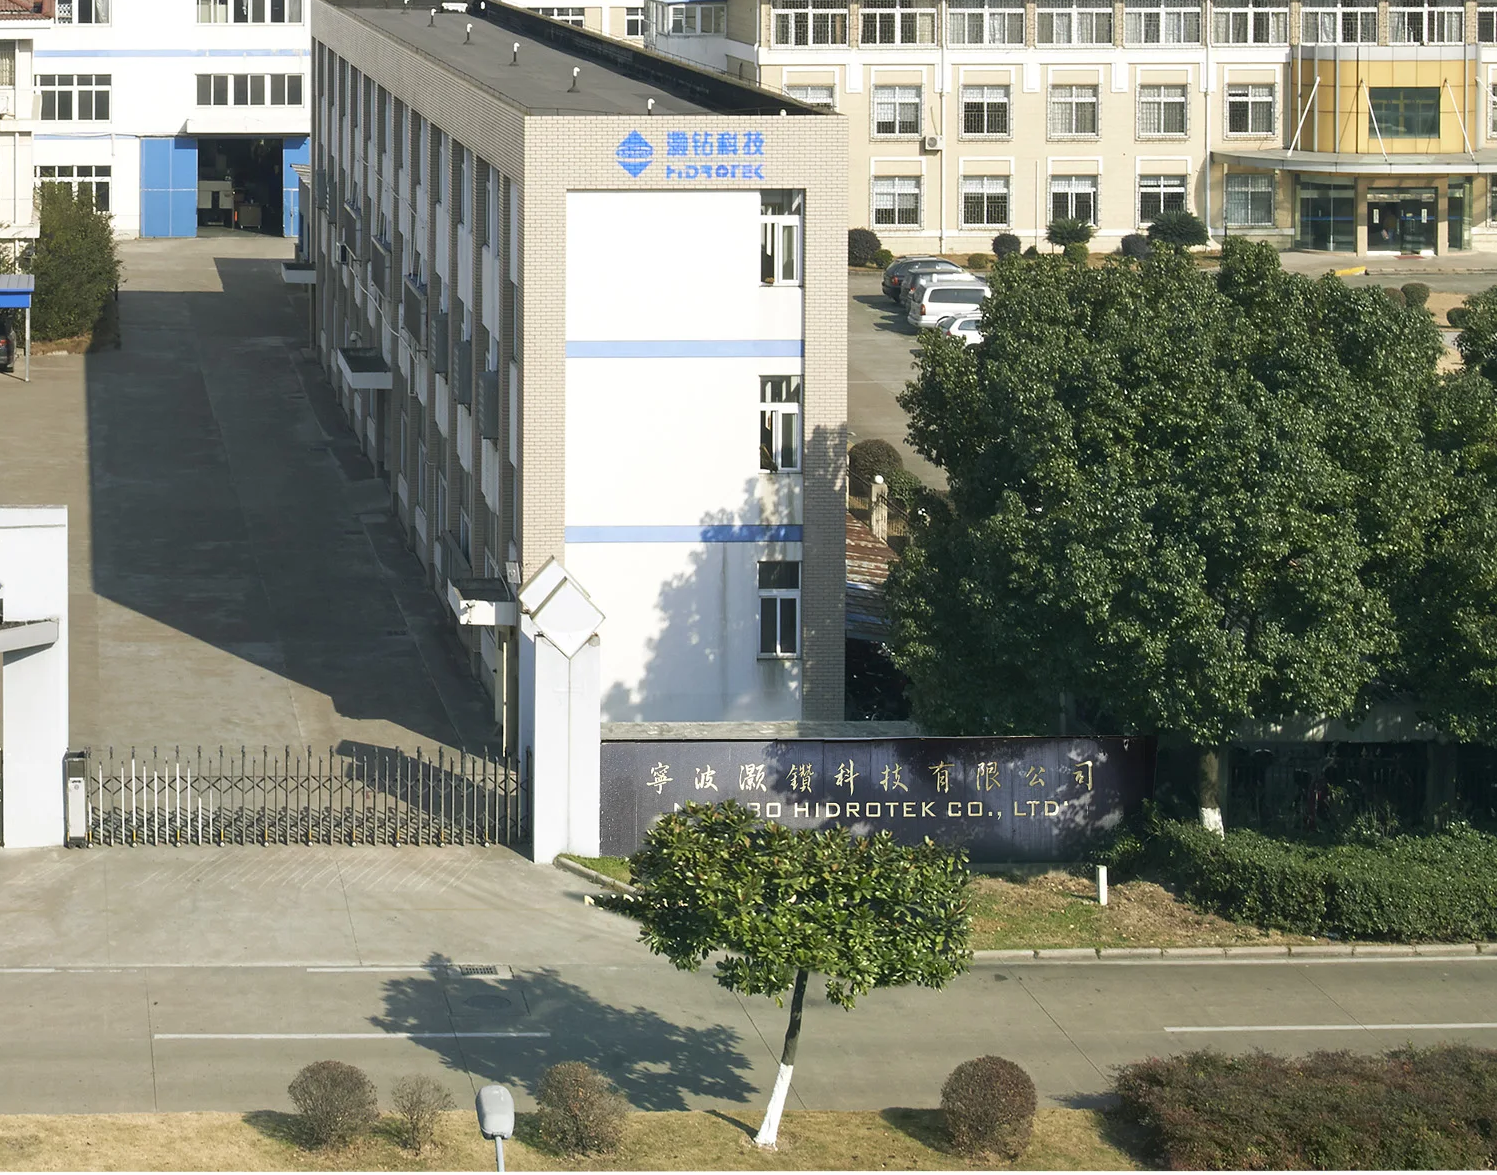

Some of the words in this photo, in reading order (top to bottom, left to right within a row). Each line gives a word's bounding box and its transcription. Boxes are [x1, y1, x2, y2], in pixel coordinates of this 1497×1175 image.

[666, 131, 765, 156] 灏钻科技
[794, 801, 936, 818] HIDROTEK
